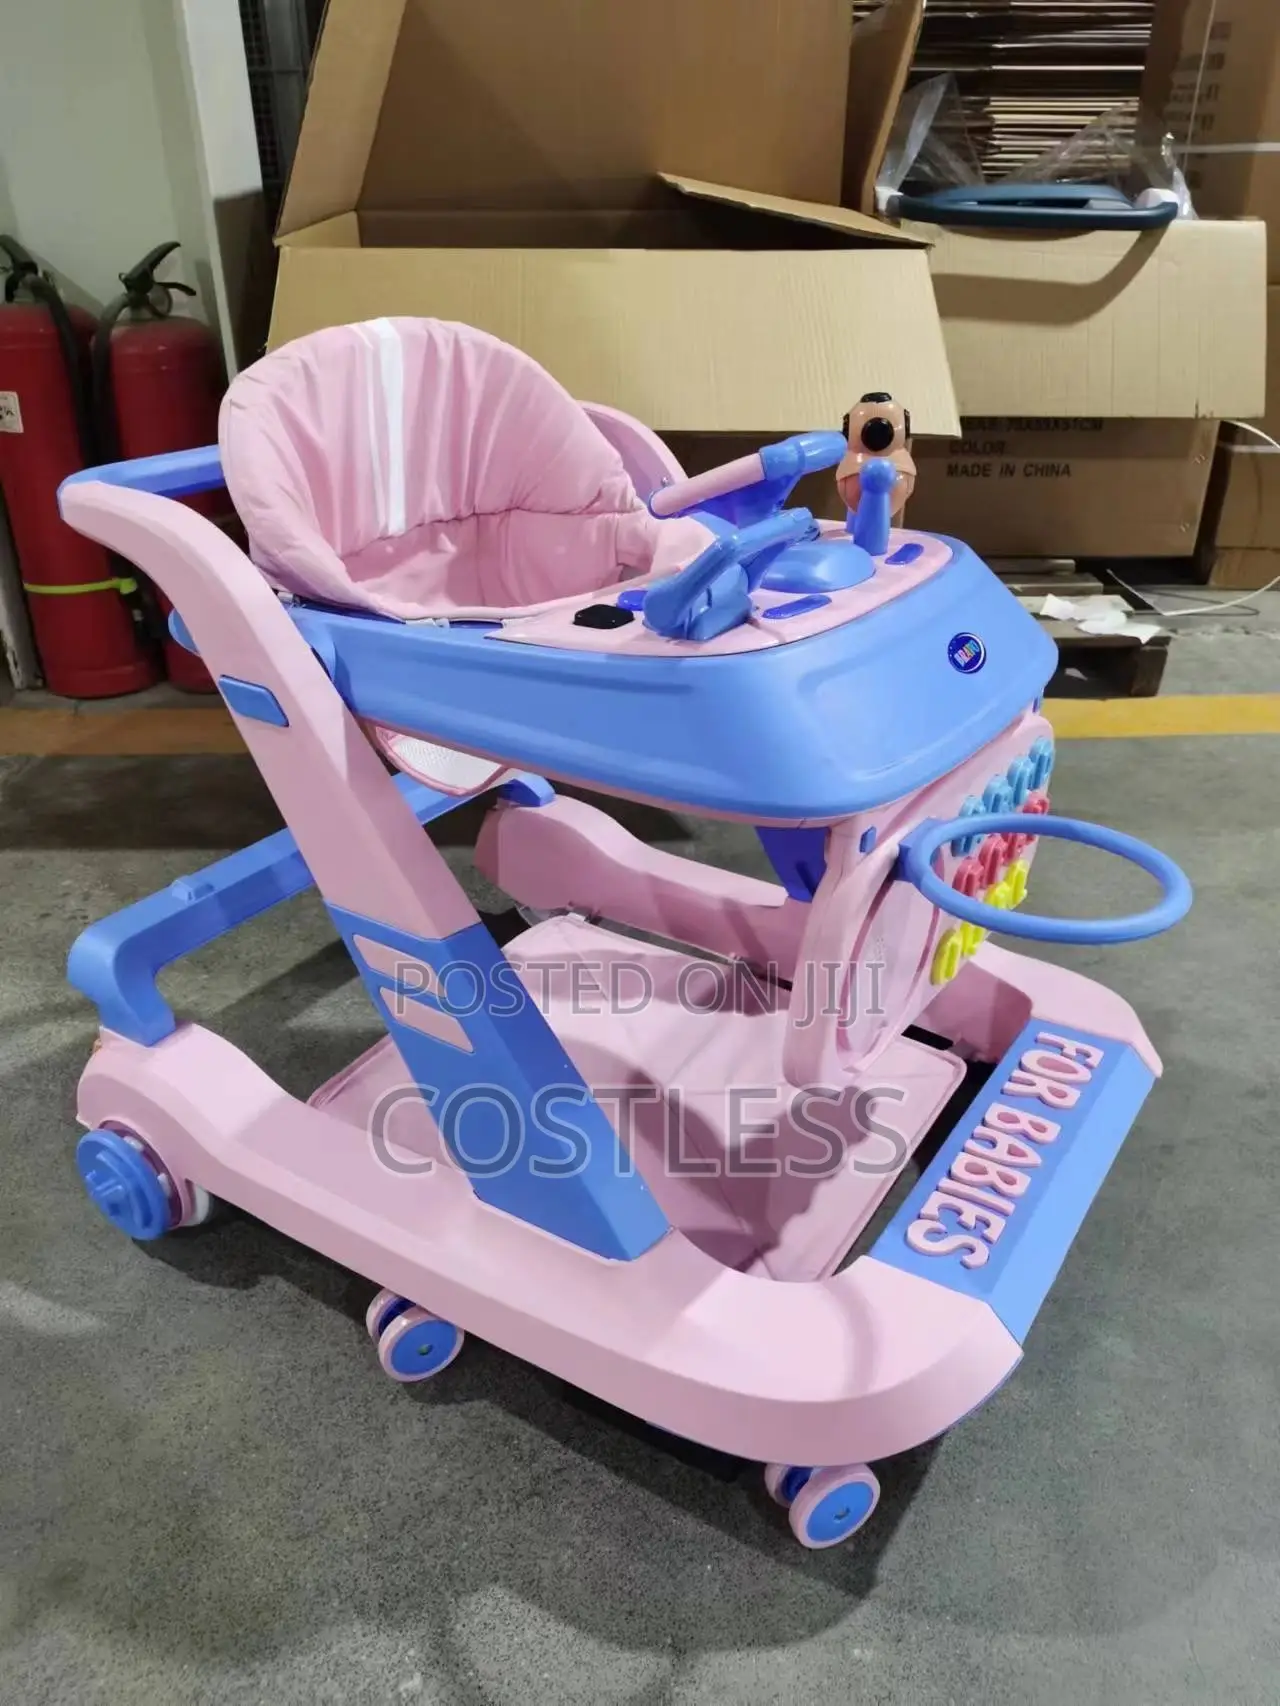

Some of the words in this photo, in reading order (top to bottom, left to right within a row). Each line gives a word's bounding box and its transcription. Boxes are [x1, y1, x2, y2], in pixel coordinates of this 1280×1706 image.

[947, 463, 992, 478] MADE
[999, 463, 1016, 478] IN
[1023, 463, 1072, 478] CHINA
[1001, 1031, 1104, 1109] FOR
[904, 1102, 1062, 1269] BABIES
